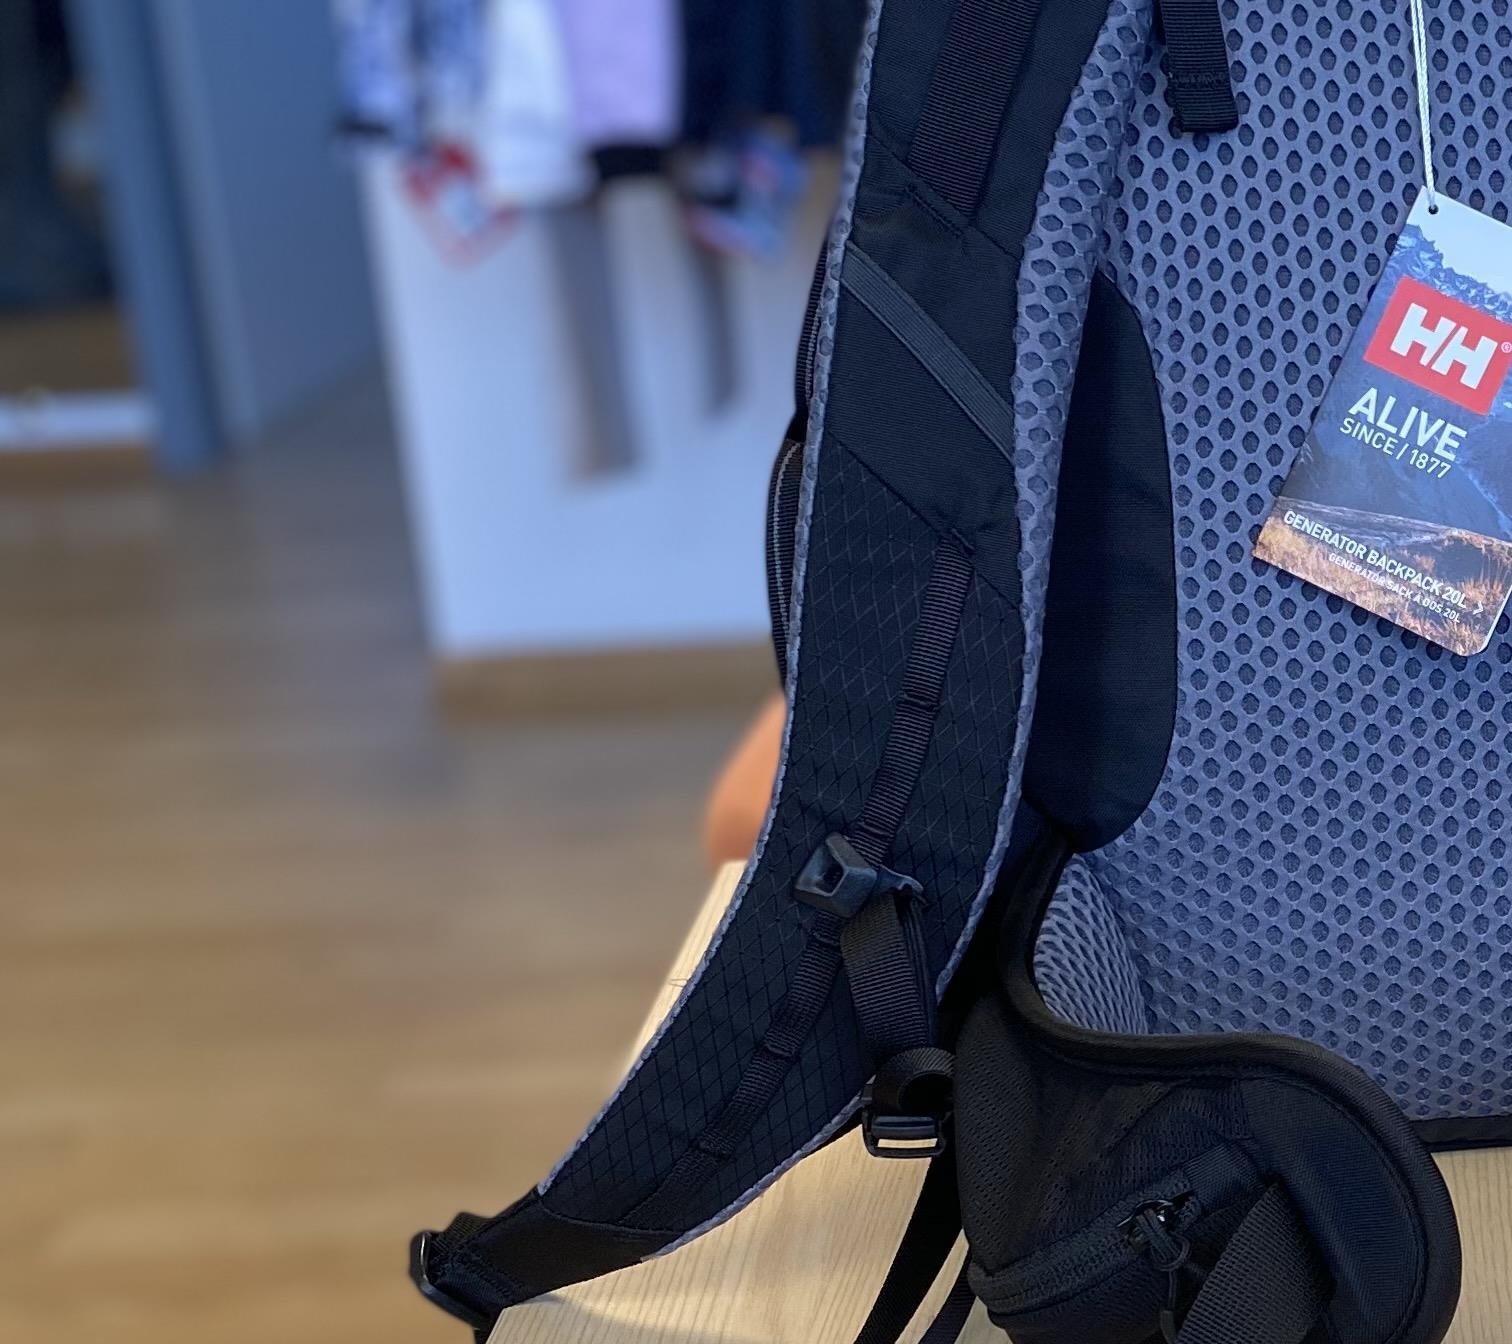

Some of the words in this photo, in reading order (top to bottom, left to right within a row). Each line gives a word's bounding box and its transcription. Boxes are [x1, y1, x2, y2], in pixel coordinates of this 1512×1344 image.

[1340, 417, 1398, 456] SINCE
[1409, 449, 1451, 478] 1877
[1348, 387, 1467, 462] ALIVE
[1283, 510, 1367, 559] GENERATOR
[1367, 549, 1444, 596] BACKPACK
[1442, 587, 1466, 609] 20L
[1328, 552, 1386, 586] GENERATOR
[1386, 580, 1413, 599] SACK
[1422, 598, 1443, 613] DOS
[1443, 608, 1460, 623] 20L
